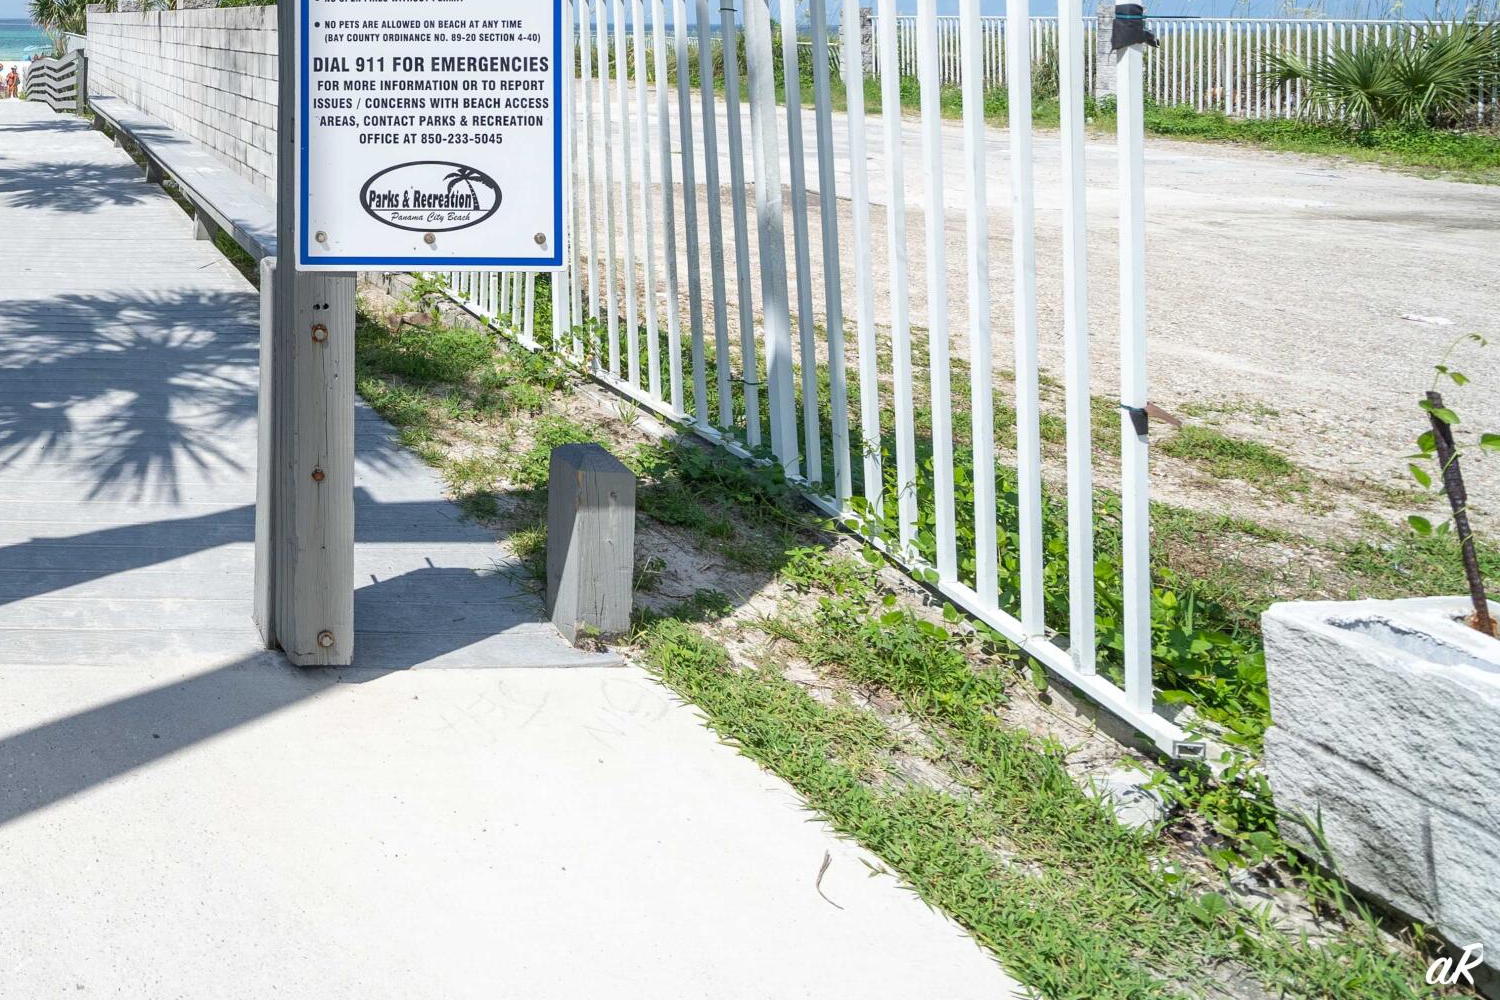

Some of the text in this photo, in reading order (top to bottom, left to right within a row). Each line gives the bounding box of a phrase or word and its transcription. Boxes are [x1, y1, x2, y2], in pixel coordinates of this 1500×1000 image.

[314, 57, 548, 72] DIAL 911 FOR EMERGENCIES
[360, 134, 502, 144] OFFICE AT 850-233-5045
[369, 190, 472, 208] Parks & Recreation
[391, 212, 470, 222] Panama City Beach
